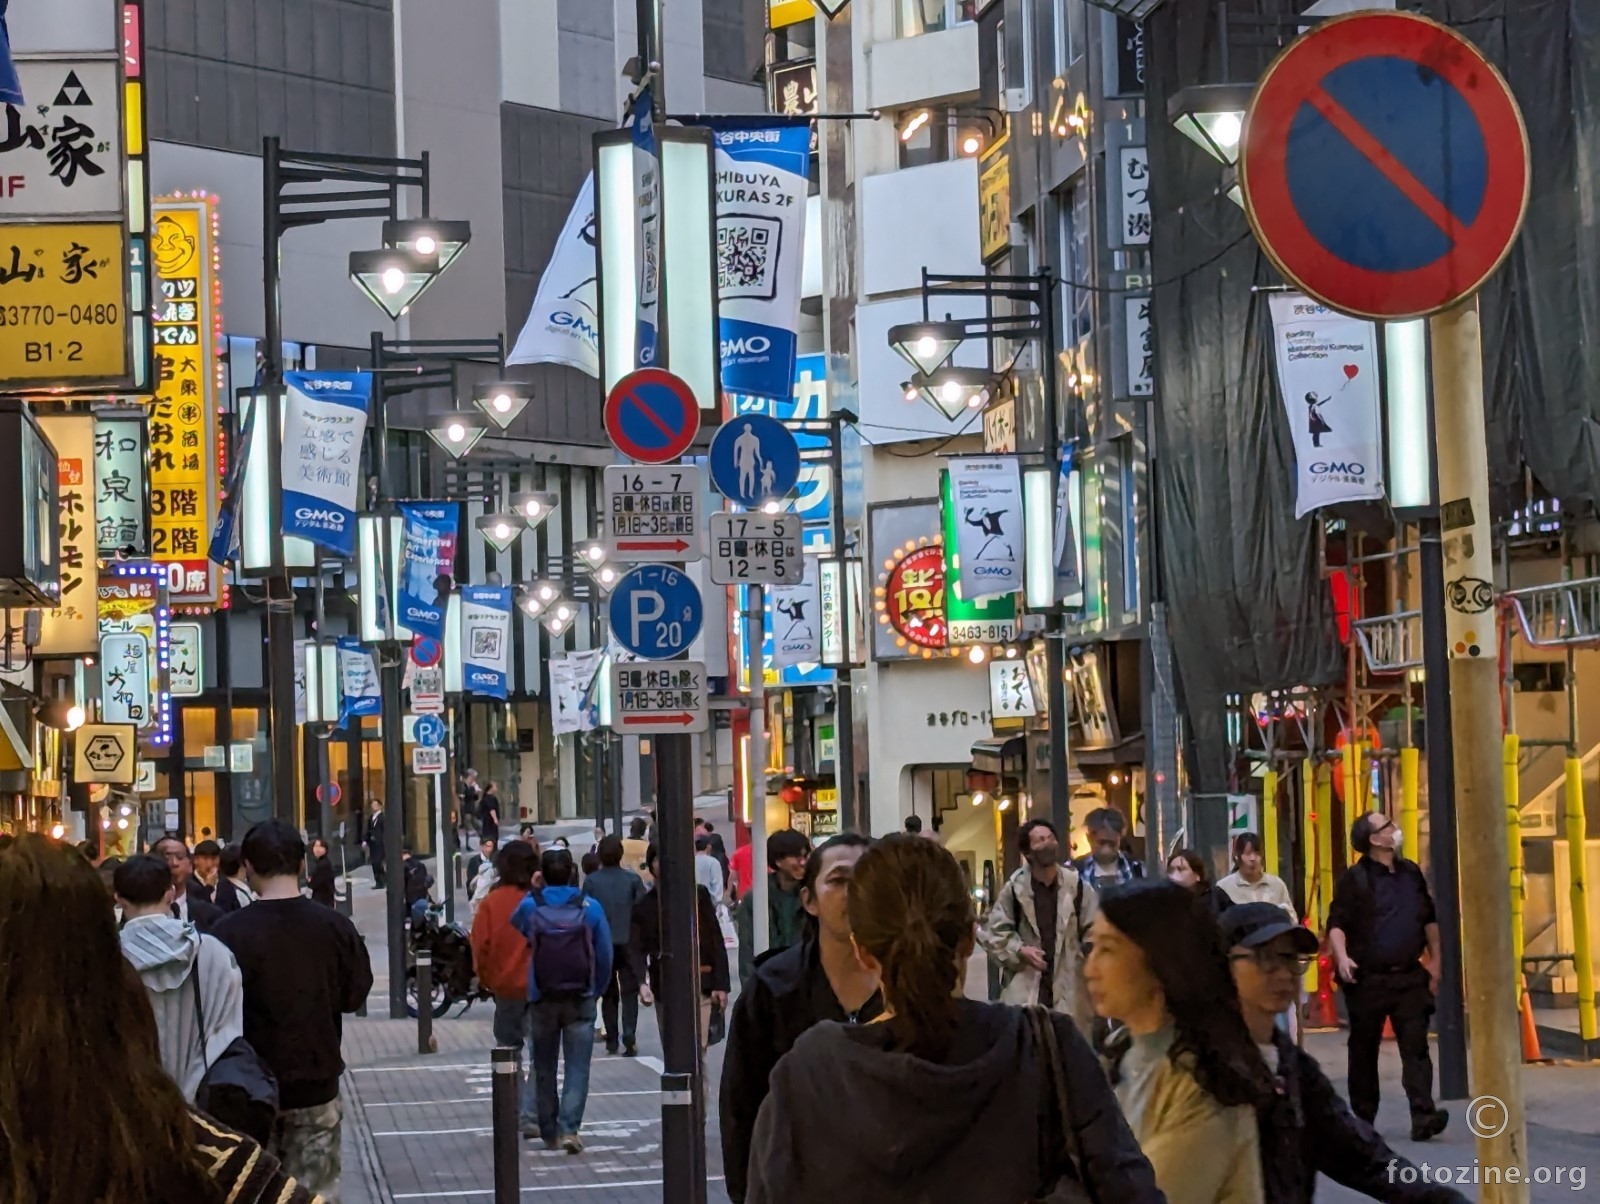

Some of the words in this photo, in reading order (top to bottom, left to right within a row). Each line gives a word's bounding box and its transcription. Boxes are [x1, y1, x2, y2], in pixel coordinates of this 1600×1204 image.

[716, 171, 781, 188] HIBUYA
[8, 303, 118, 326] 3770-0480
[1309, 461, 1365, 475] GMO
[152, 489, 198, 517] 3階
[295, 507, 345, 524] GMO
[59, 490, 85, 595] ホルモン
[152, 527, 199, 555] 2階
[973, 566, 1012, 576] GMO
[407, 607, 440, 621] GMO
[630, 590, 665, 647] P
[99, 619, 133, 633] ビール
[953, 624, 1013, 640] 3463-8151
